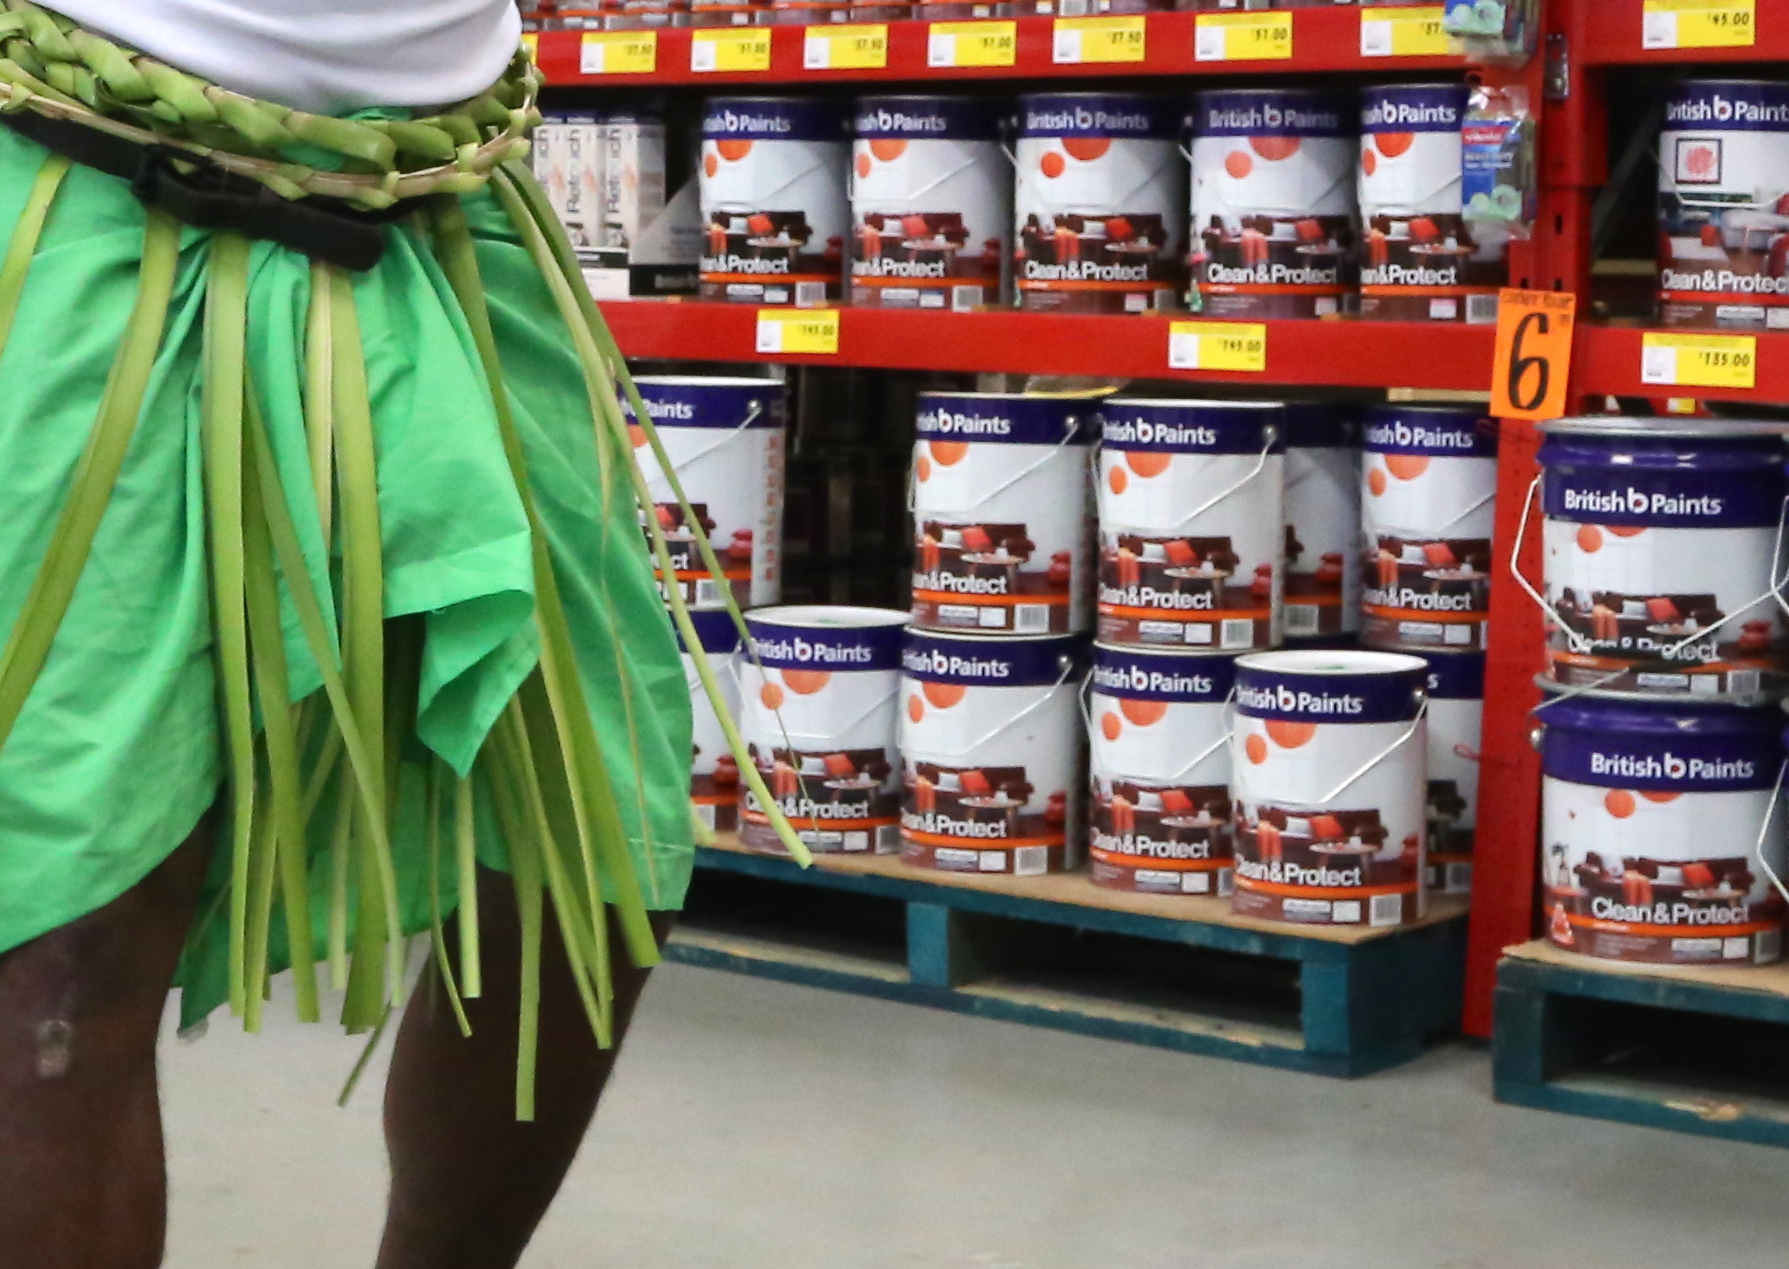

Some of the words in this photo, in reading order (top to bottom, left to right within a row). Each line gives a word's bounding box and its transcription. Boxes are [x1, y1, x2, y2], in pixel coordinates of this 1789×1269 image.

[740, 114, 790, 132] Paints
[893, 113, 946, 132] Paints
[1027, 112, 1072, 129] British
[1095, 111, 1148, 130] Paints
[1209, 111, 1261, 128] British
[1285, 111, 1336, 128] Paints
[1399, 104, 1456, 123] Paints
[1025, 260, 1148, 281] Clean&Protect
[1208, 263, 1336, 283] Clean&Protect
[1507, 311, 1549, 412] 6
[955, 416, 1010, 436] Paints
[1154, 425, 1216, 445] Paints
[1413, 427, 1472, 448] Paints
[1565, 490, 1624, 512] British
[1652, 490, 1721, 515] Paints
[814, 642, 871, 661] Paints
[950, 657, 1008, 677] Paints
[1151, 671, 1211, 691] Paints
[1298, 692, 1362, 714] Paints
[1592, 754, 1662, 777] British
[1690, 759, 1753, 778] Paints
[1592, 897, 1749, 924] Clean&Protect
